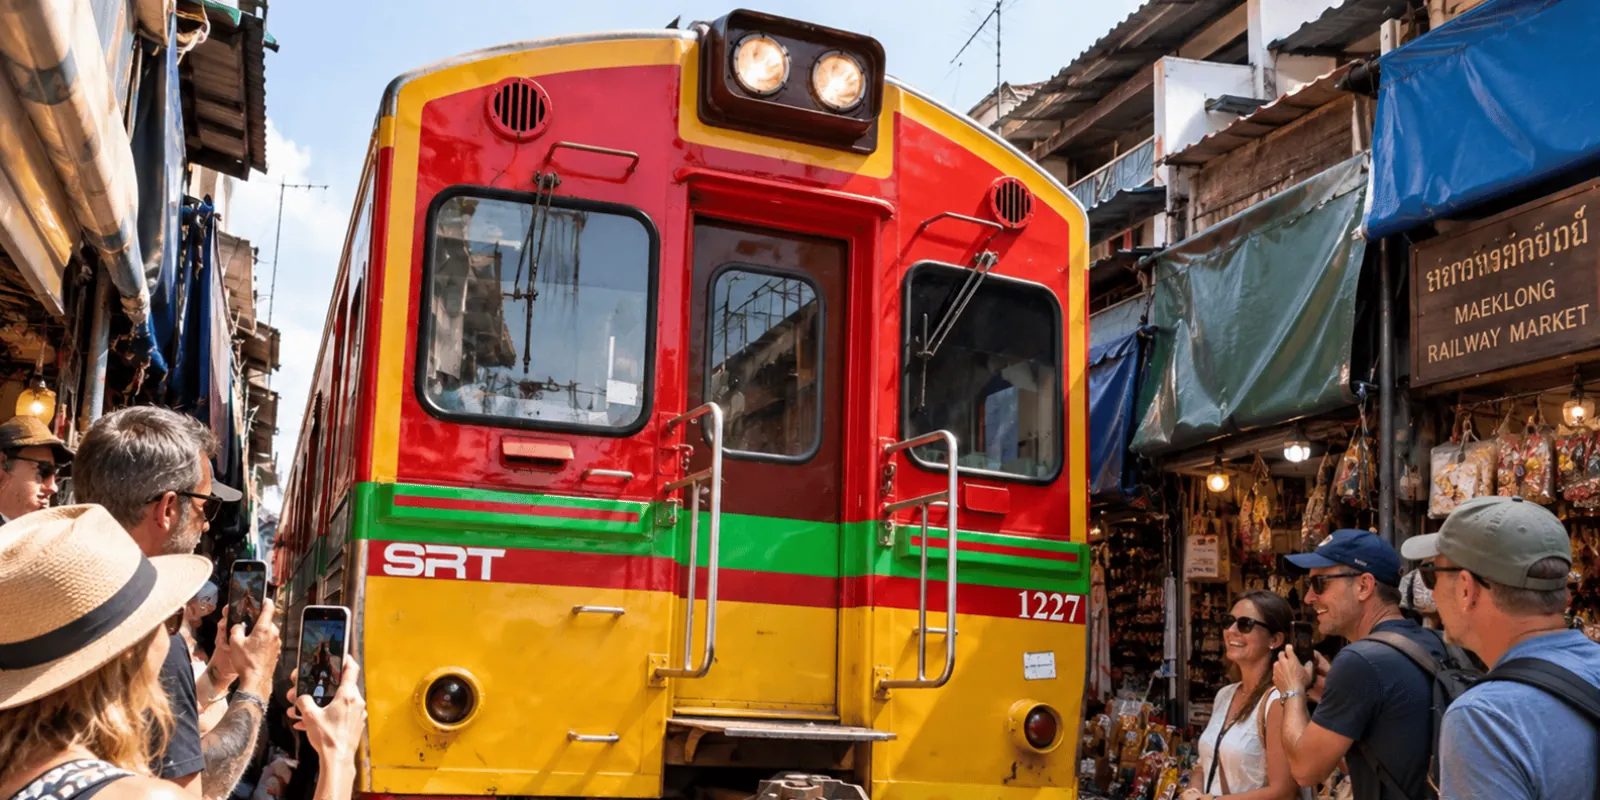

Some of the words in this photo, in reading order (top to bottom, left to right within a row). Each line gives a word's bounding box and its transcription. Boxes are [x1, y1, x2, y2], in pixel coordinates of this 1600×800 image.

[1454, 279, 1555, 325] MAEKLONG
[1427, 327, 1501, 363] RAILWAY
[1509, 304, 1589, 343] MARKET
[383, 542, 506, 580] SRT
[1018, 590, 1080, 622] 1227
